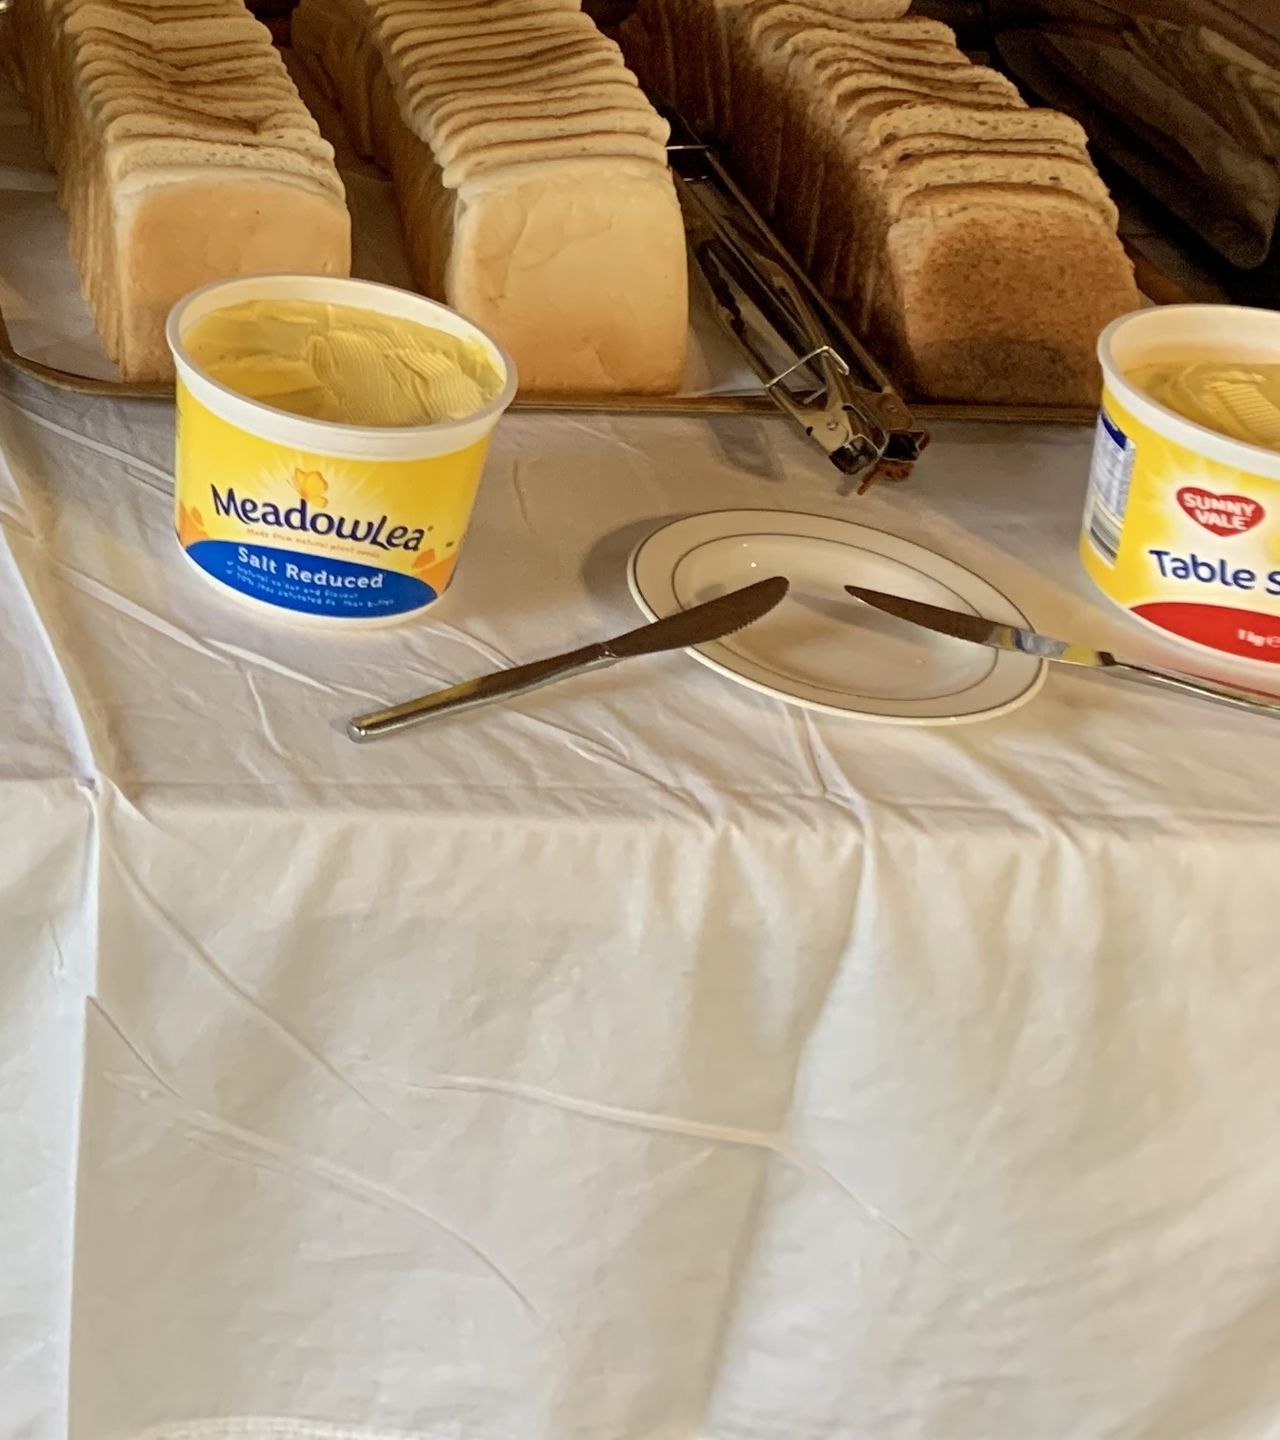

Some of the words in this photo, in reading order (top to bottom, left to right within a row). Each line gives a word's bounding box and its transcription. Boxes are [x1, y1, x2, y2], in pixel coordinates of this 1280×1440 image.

[1182, 492, 1256, 517] SUNNY
[1195, 509, 1248, 531] VALE
[237, 546, 278, 575] Salt
[285, 562, 384, 589] Reduced
[1148, 549, 1257, 590] Table
